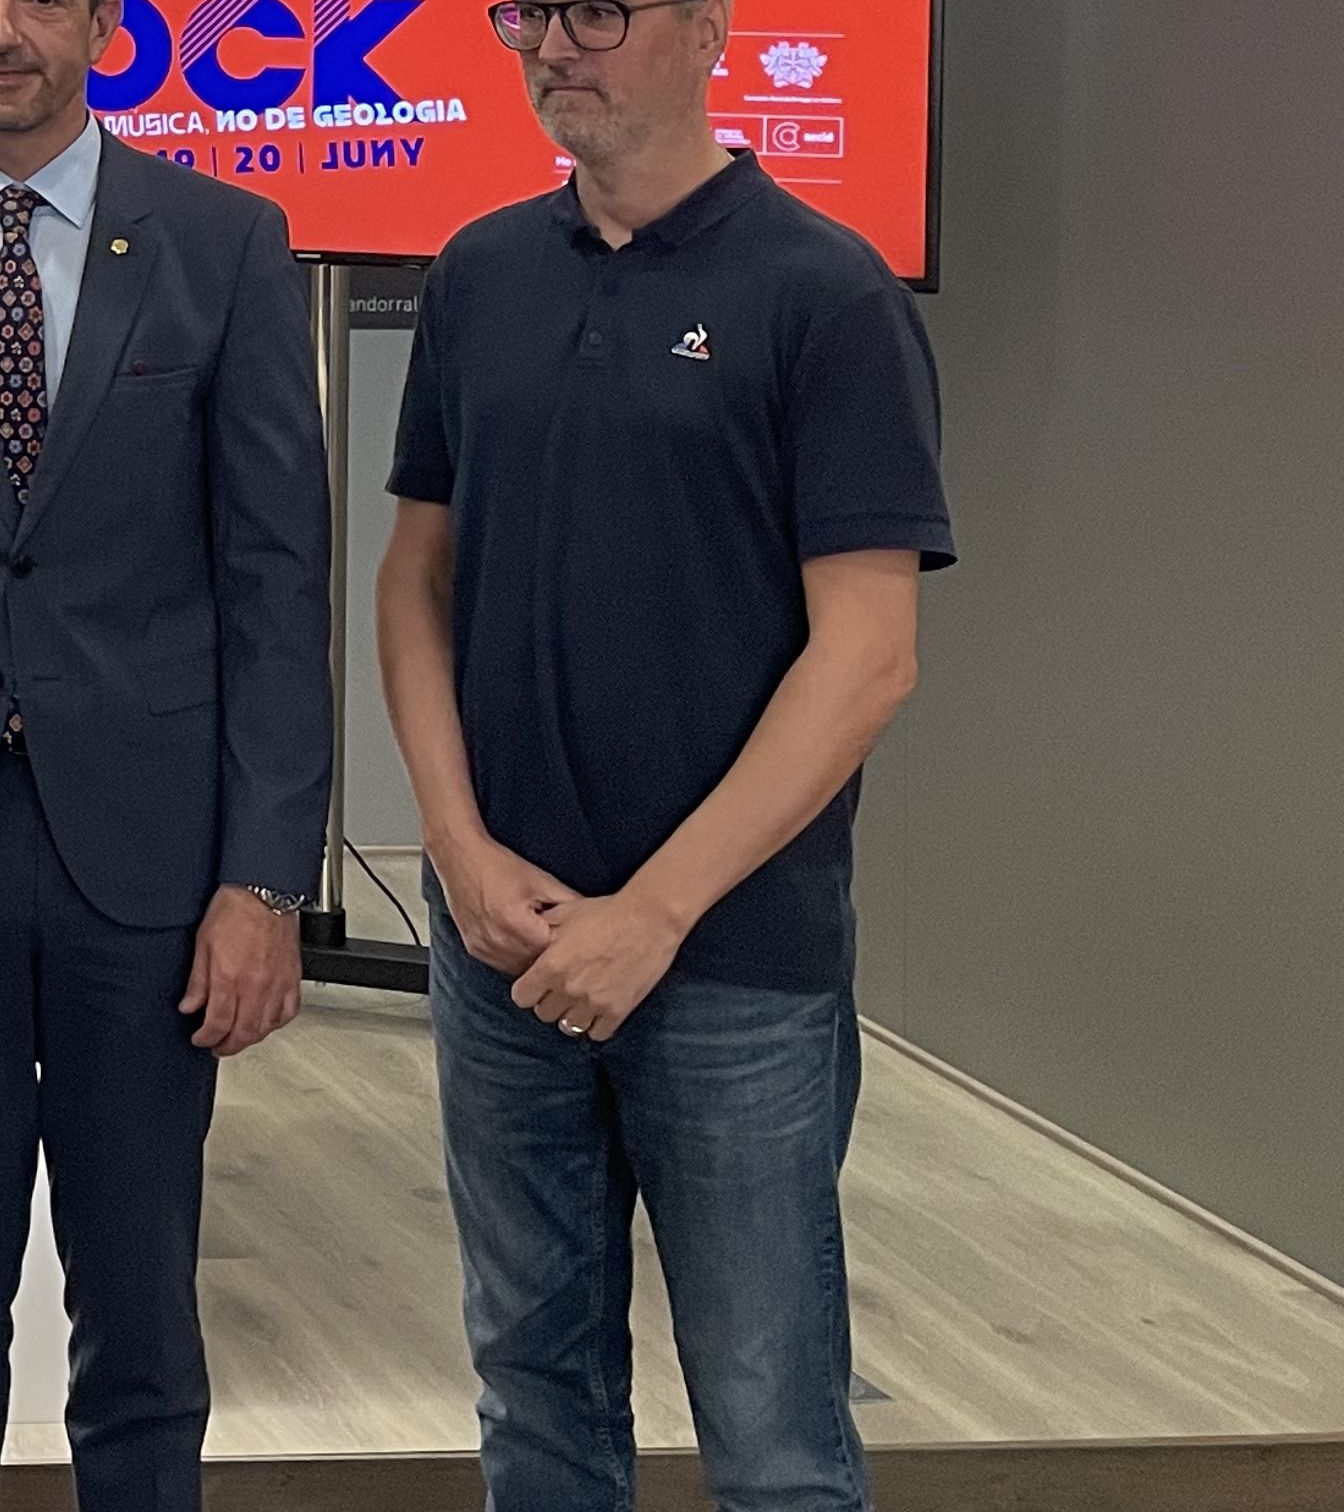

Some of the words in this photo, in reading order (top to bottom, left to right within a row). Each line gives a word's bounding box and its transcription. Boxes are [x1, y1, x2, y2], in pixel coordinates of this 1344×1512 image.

[216, 108, 259, 133] NO
[264, 106, 306, 131] DE
[313, 98, 468, 128] GEOLOGIA
[235, 144, 281, 174] 20
[321, 137, 425, 170] JUNY
